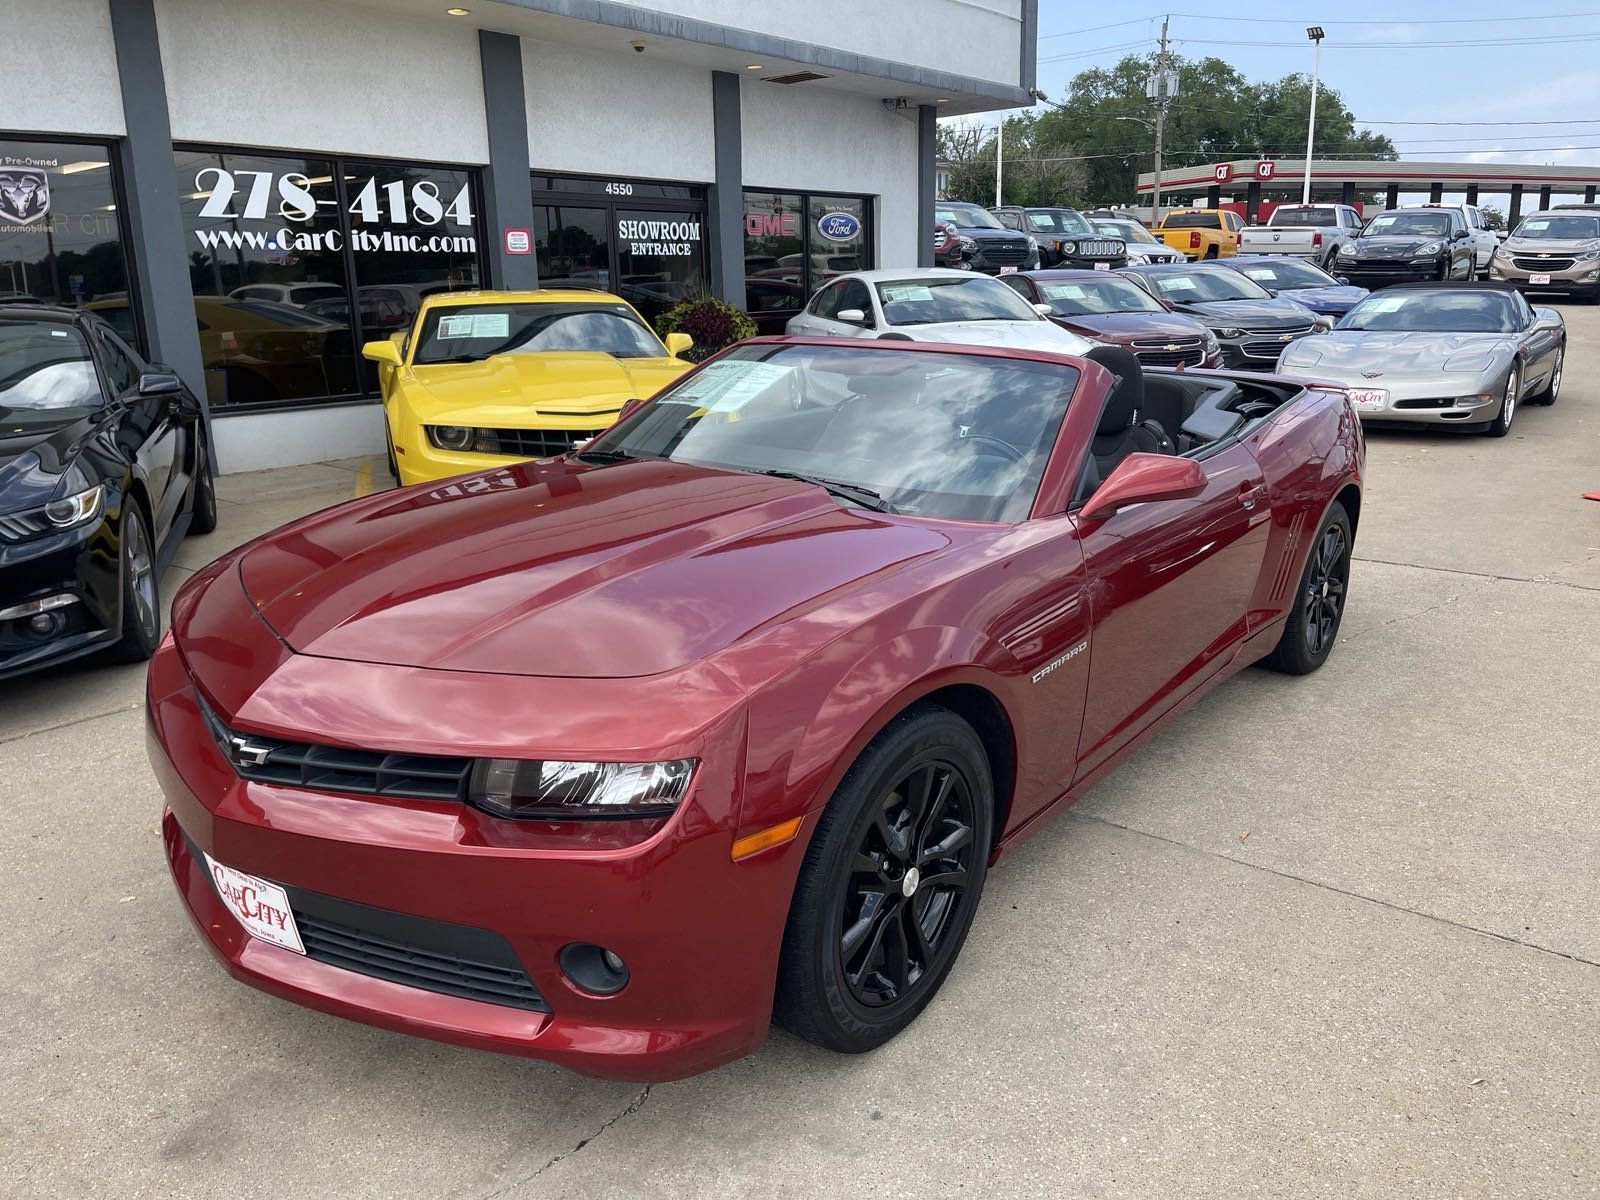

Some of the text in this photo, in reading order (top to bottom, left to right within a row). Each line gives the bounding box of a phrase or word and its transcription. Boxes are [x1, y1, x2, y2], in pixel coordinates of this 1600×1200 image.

[5, 157, 58, 166] Pre-Owned
[1260, 163, 1272, 176] QT
[1216, 166, 1228, 179] QT
[195, 168, 475, 225] 278-4184
[605, 183, 633, 195] 4550
[619, 220, 700, 241] SHOWROOM
[746, 213, 797, 236] GMC
[828, 217, 852, 235] Ford
[194, 228, 477, 253] www.CarCityInc.com
[630, 243, 692, 256] ENTRANCE
[1032, 641, 1088, 684] CAMARO
